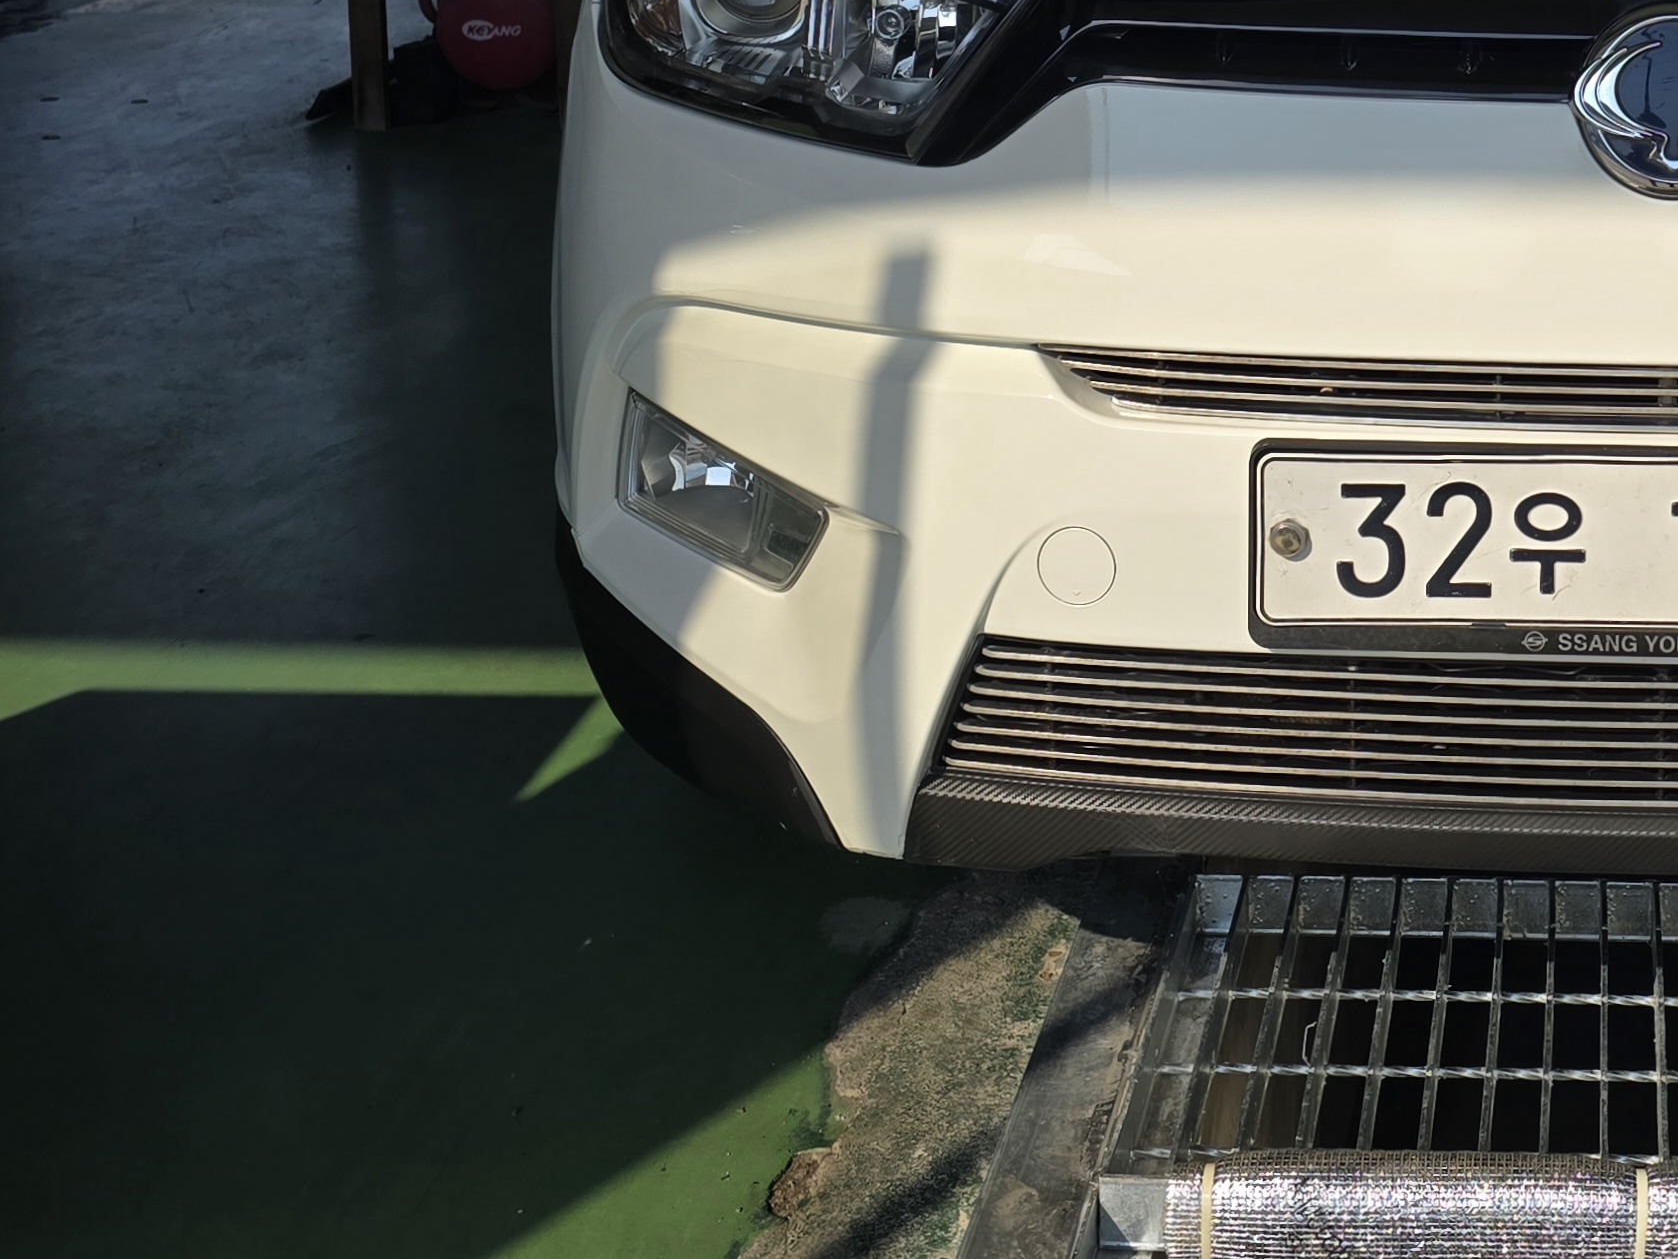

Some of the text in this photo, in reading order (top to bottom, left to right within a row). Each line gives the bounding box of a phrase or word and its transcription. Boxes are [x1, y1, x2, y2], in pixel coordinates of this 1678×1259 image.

[462, 21, 522, 40] KEYANG
[1335, 481, 1587, 599] 32우
[1557, 633, 1638, 653] SSANG
